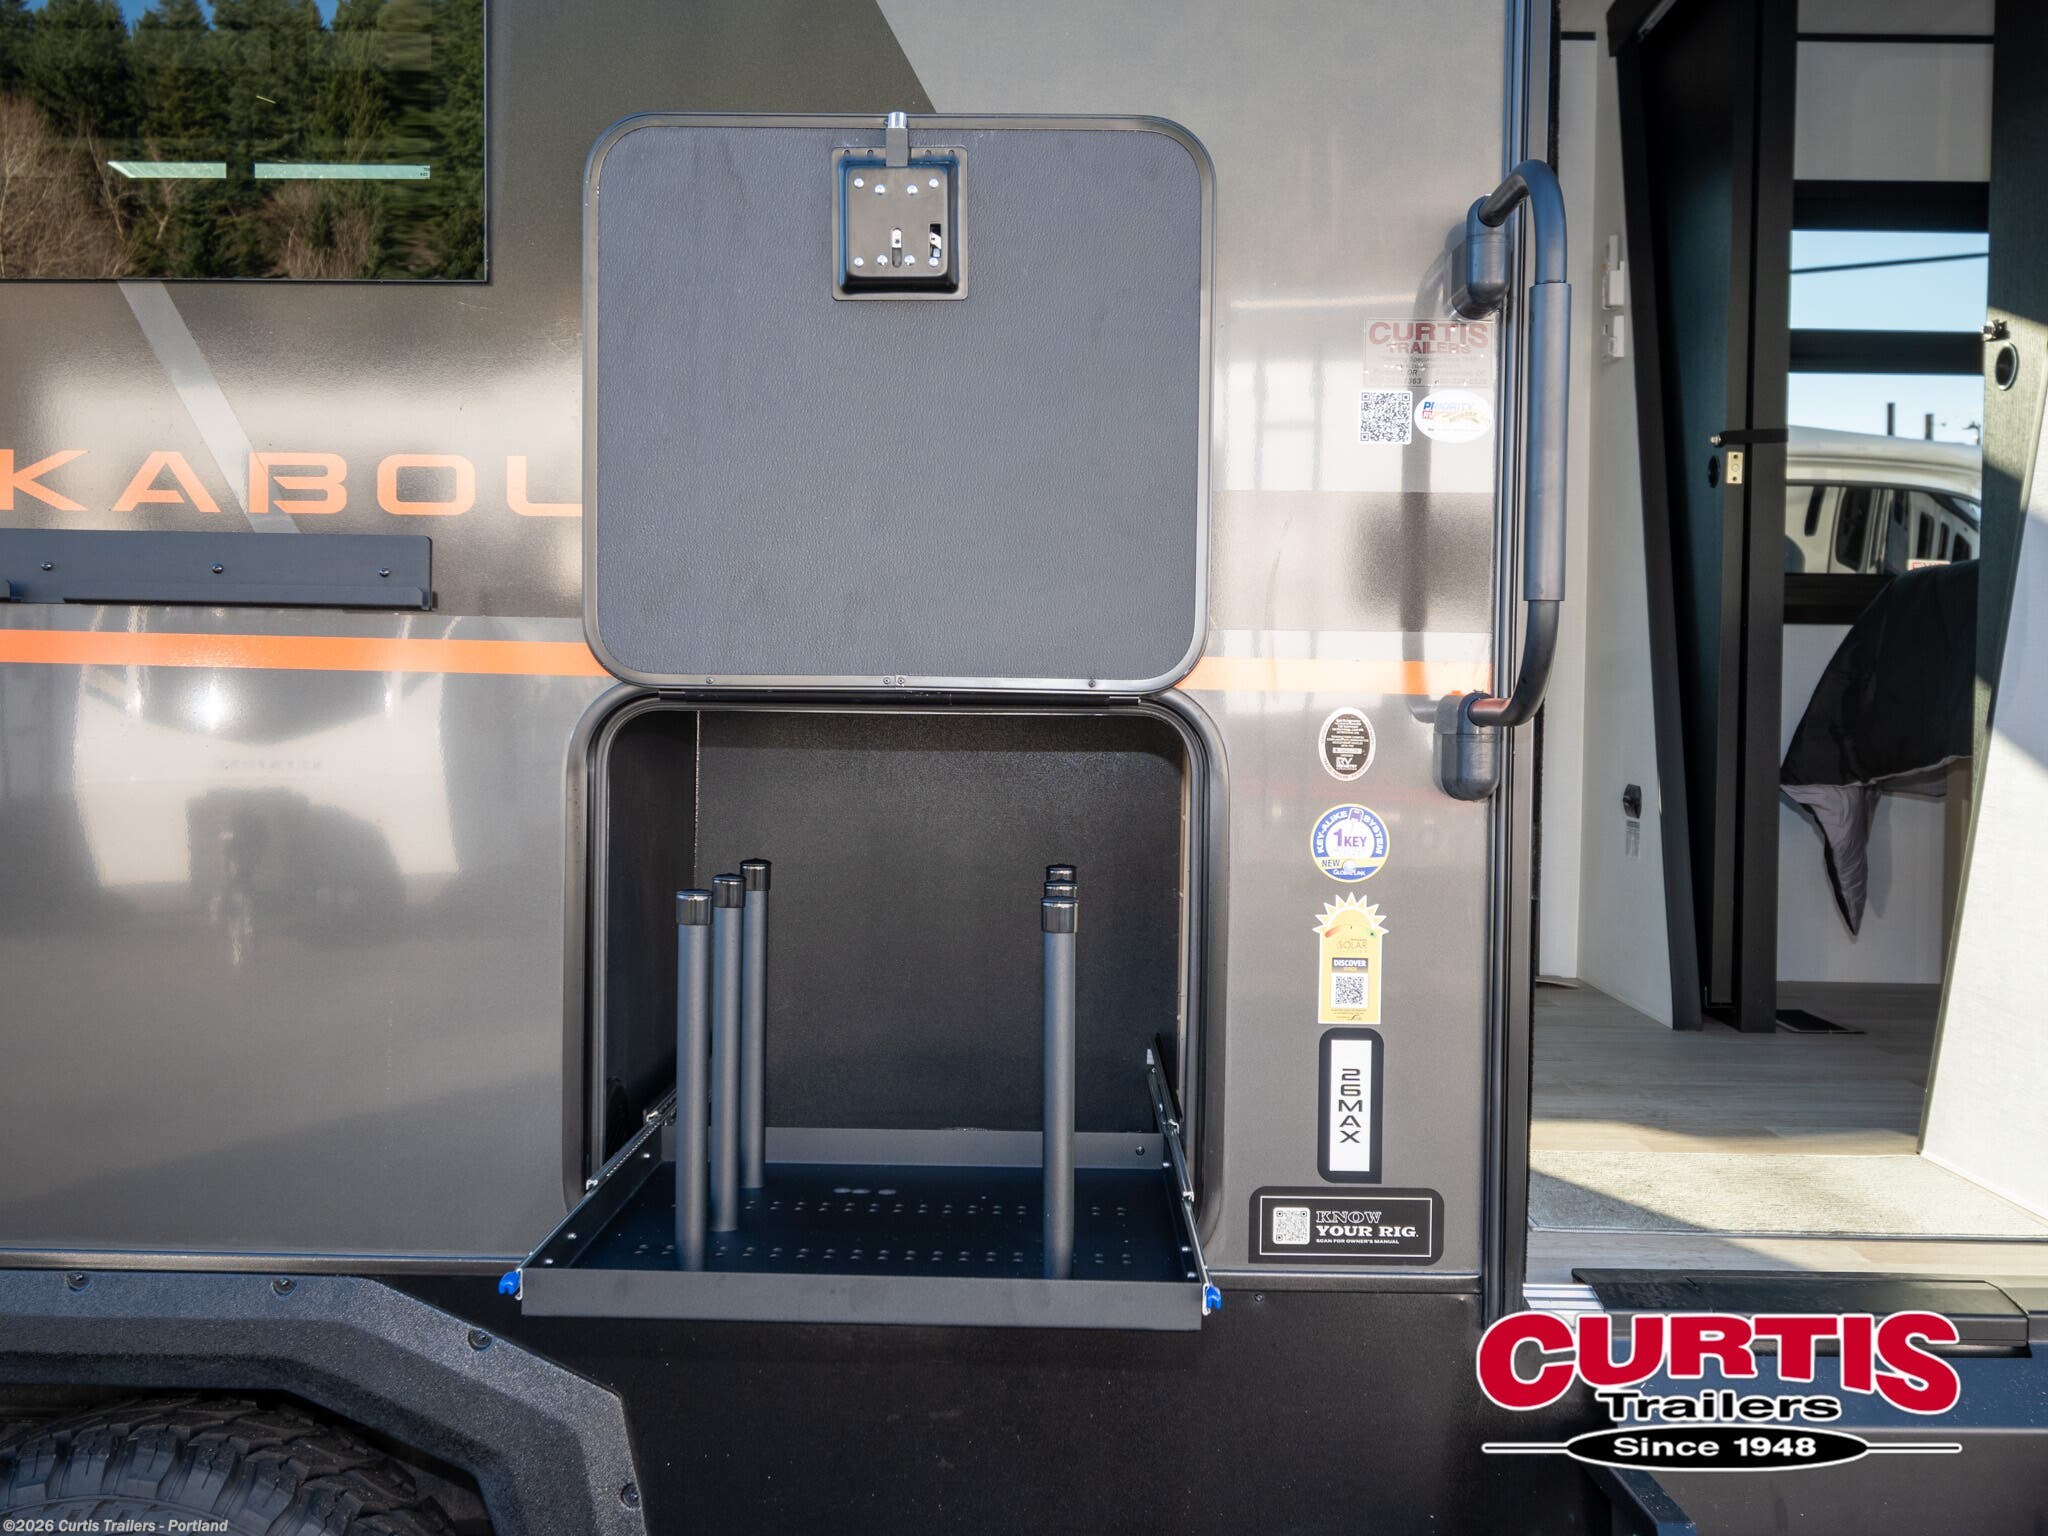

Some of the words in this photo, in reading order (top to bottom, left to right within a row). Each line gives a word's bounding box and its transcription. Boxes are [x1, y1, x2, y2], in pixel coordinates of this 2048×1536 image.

[1368, 321, 1489, 348] CURTIS
[1386, 342, 1473, 354] TRAILERS
[1333, 828, 1343, 847] 1
[1344, 836, 1367, 847] KEY
[1322, 859, 1341, 867] NEW
[1337, 940, 1368, 949] SOLAR
[1333, 959, 1367, 967] DISCOVER
[1338, 1068, 1363, 1143] 26MAX
[1315, 1211, 1382, 1224] KNOW
[1316, 1225, 1373, 1237] YOUR
[1378, 1226, 1419, 1238] RIG.
